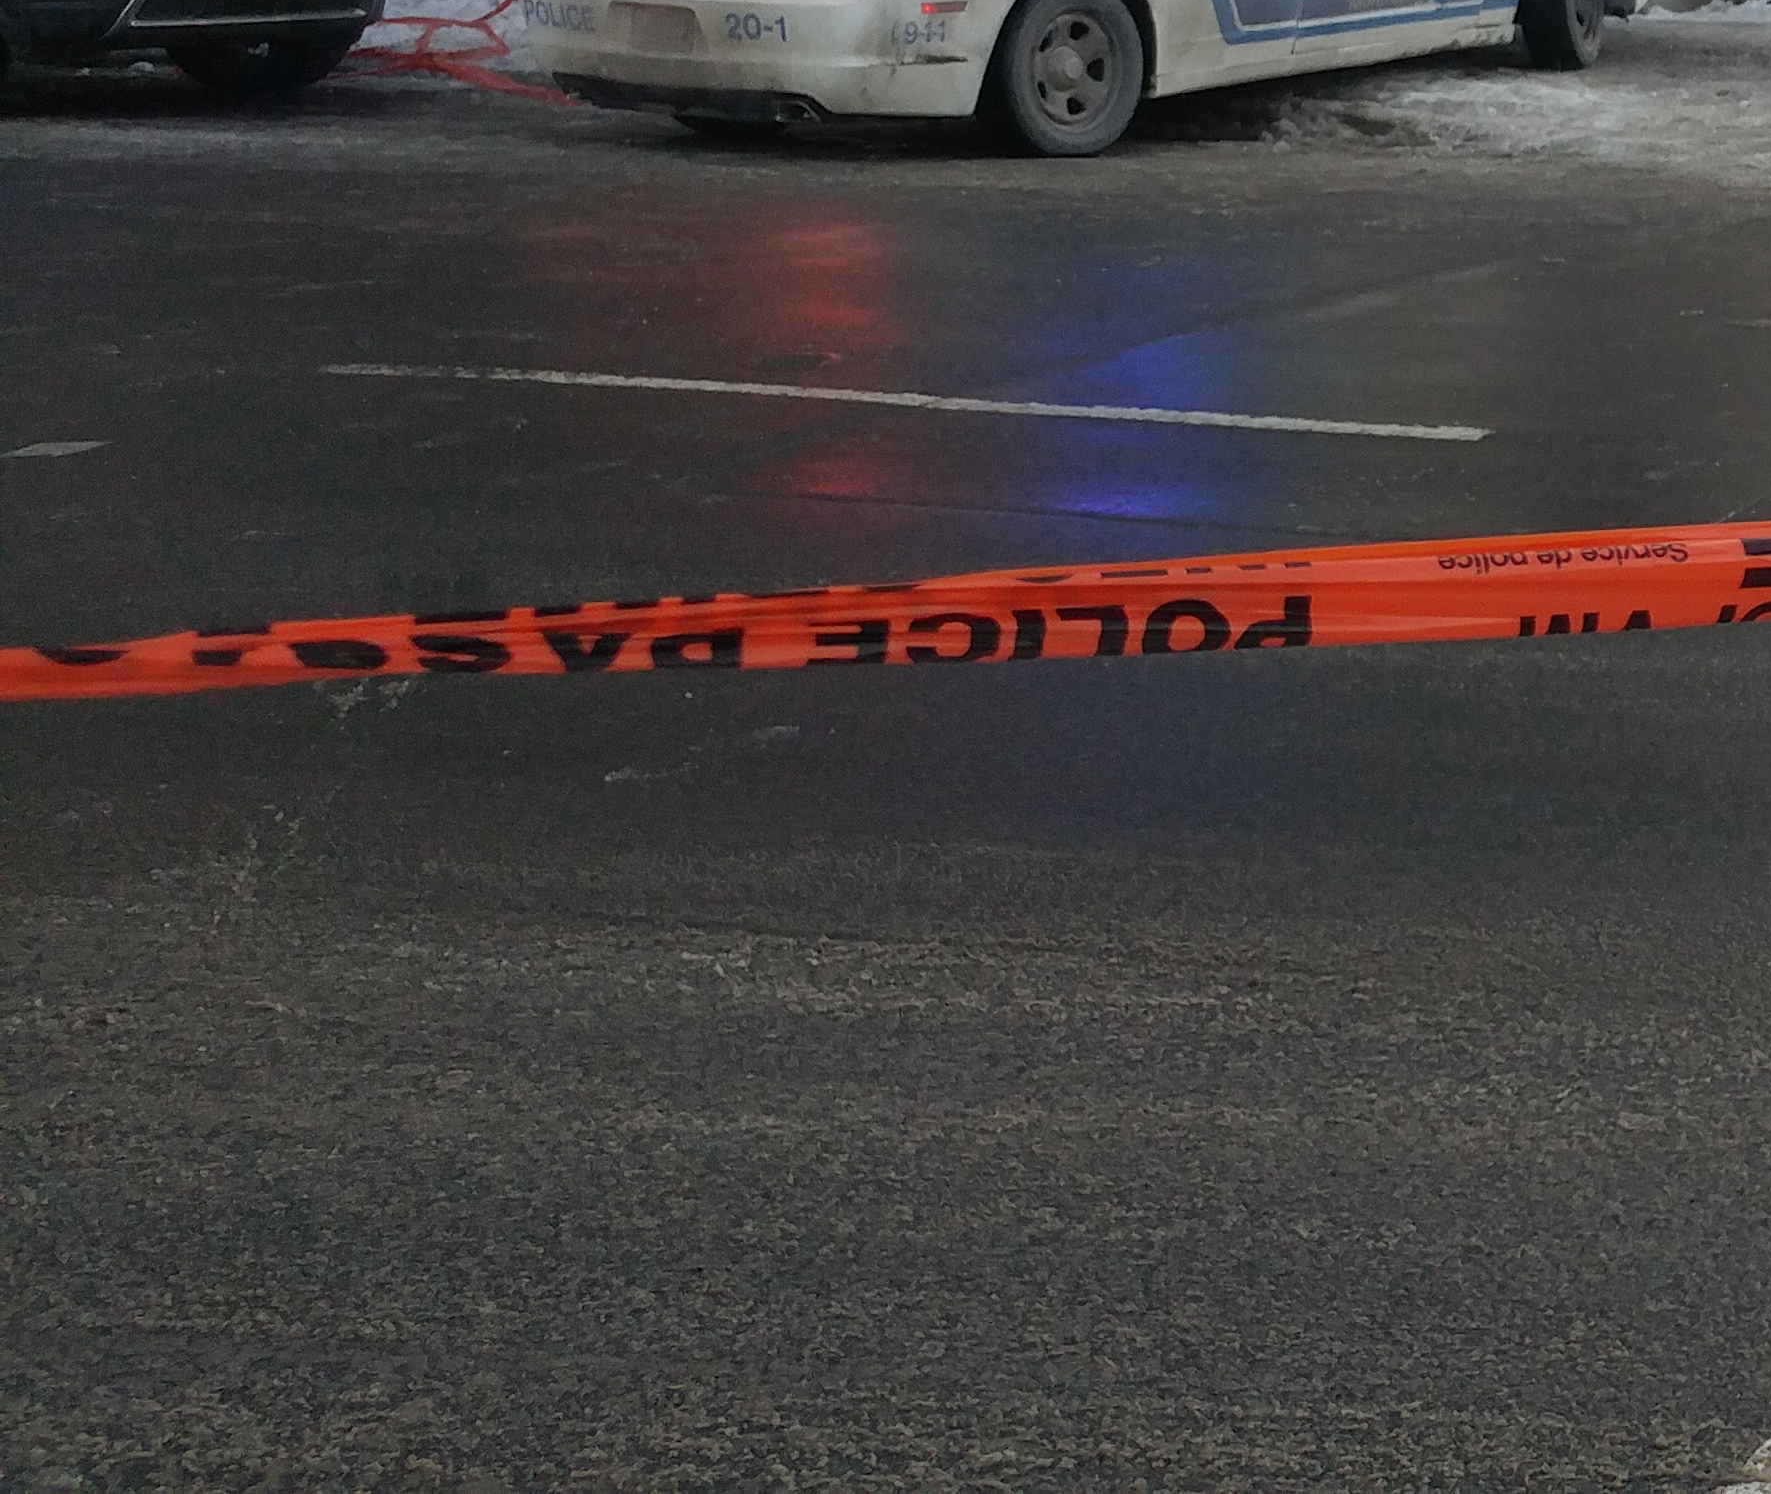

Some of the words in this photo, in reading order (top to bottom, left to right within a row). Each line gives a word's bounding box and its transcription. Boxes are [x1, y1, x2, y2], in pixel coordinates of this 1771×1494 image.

[725, 12, 788, 43] 20-1
[902, 21, 948, 45] 9-1-1
[1534, 547, 1574, 570] de
[1581, 541, 1690, 568] Service
[806, 594, 1313, 666] POLICE
